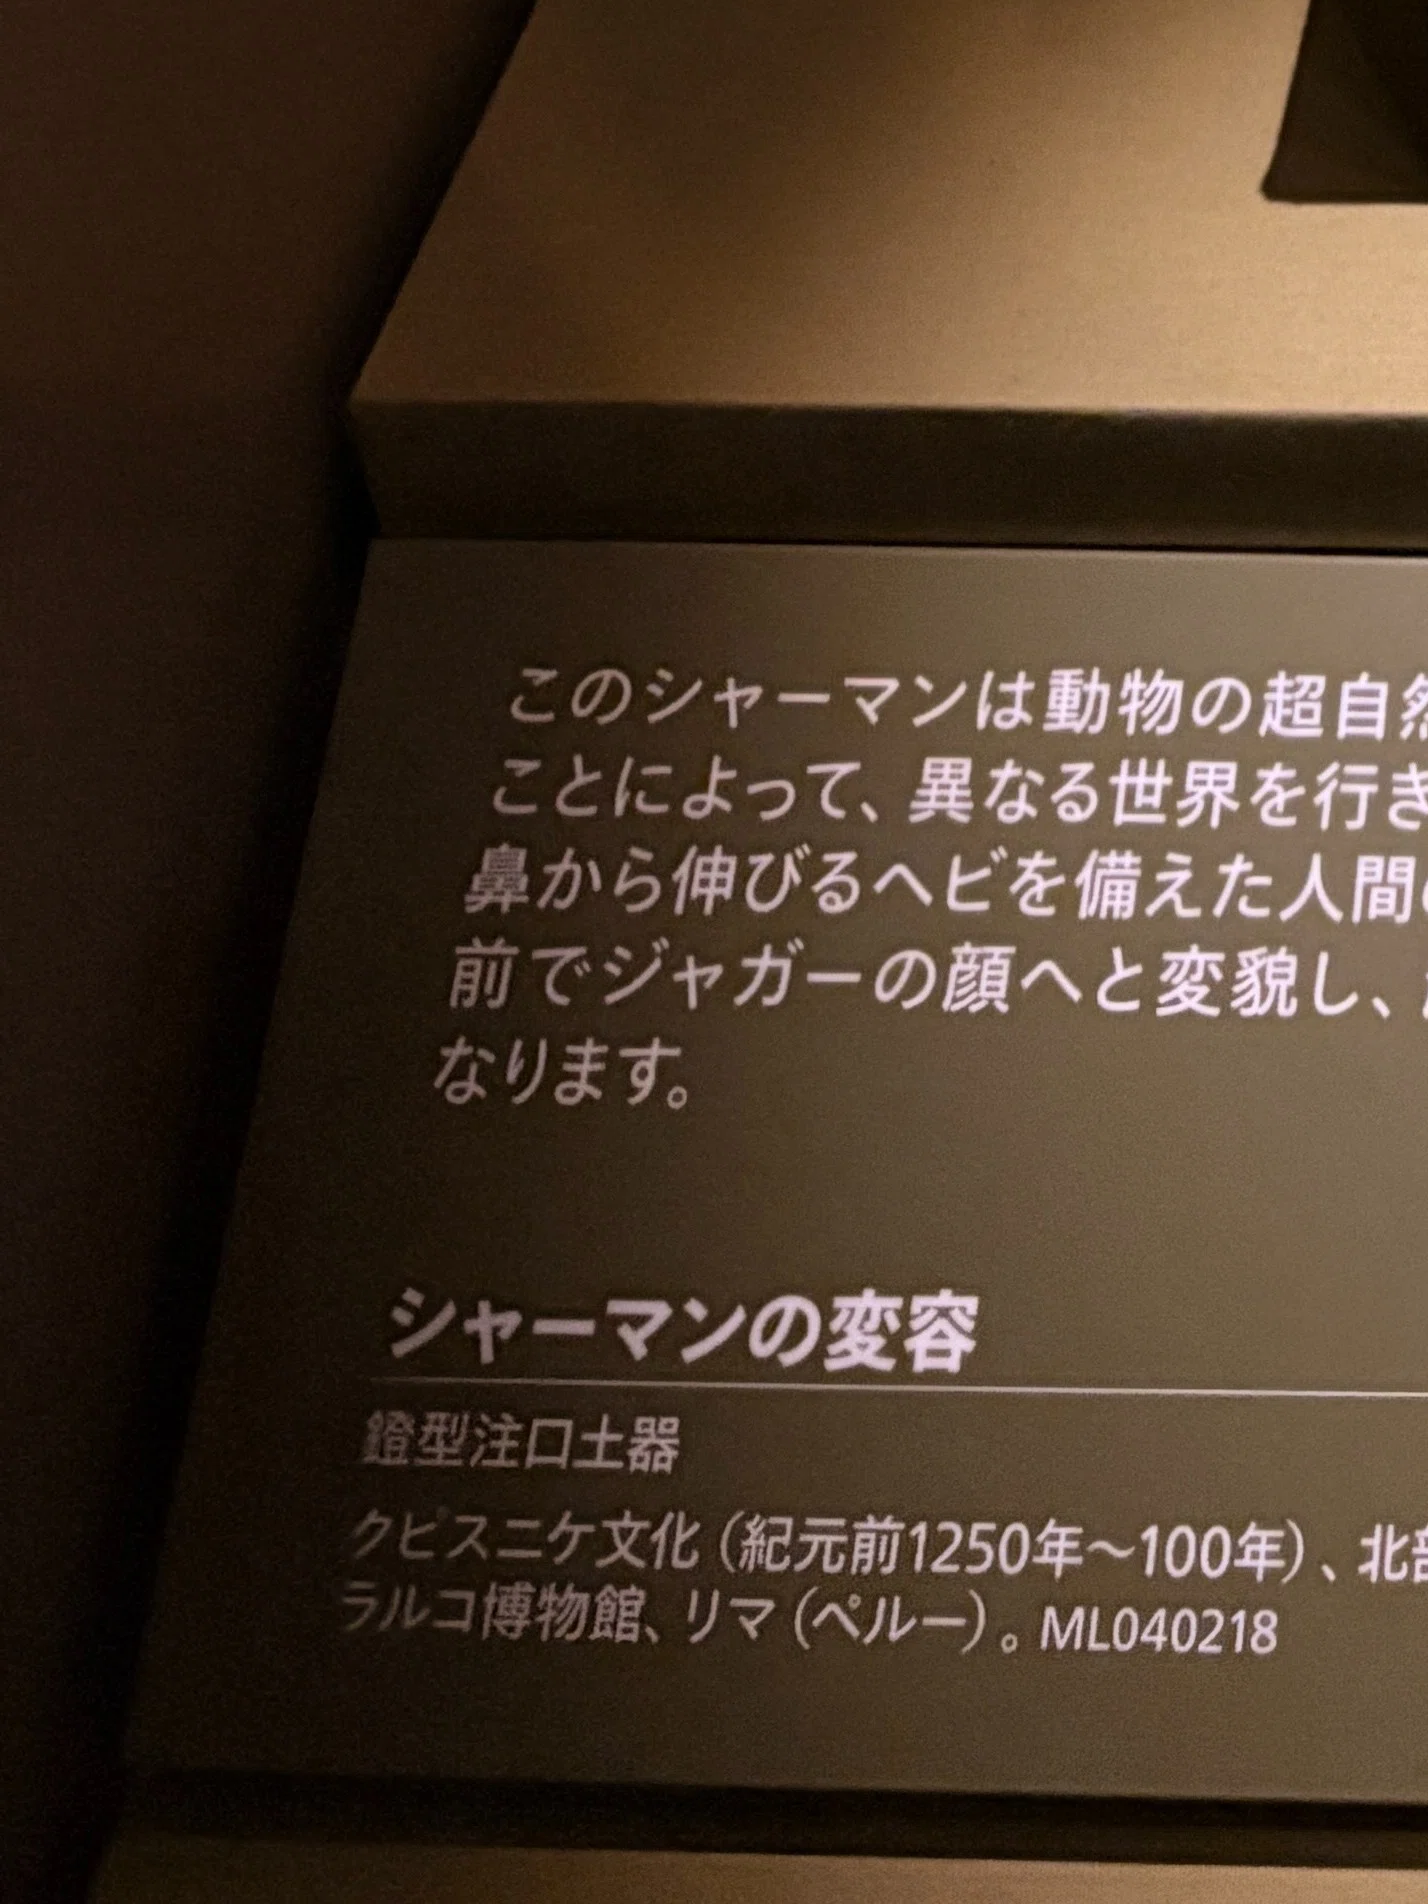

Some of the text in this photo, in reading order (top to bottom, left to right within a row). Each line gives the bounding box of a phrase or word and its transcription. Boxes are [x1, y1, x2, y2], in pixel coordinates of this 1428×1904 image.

[433, 1036, 689, 1111] なります。
[392, 1288, 980, 1374] シャーマンの変容
